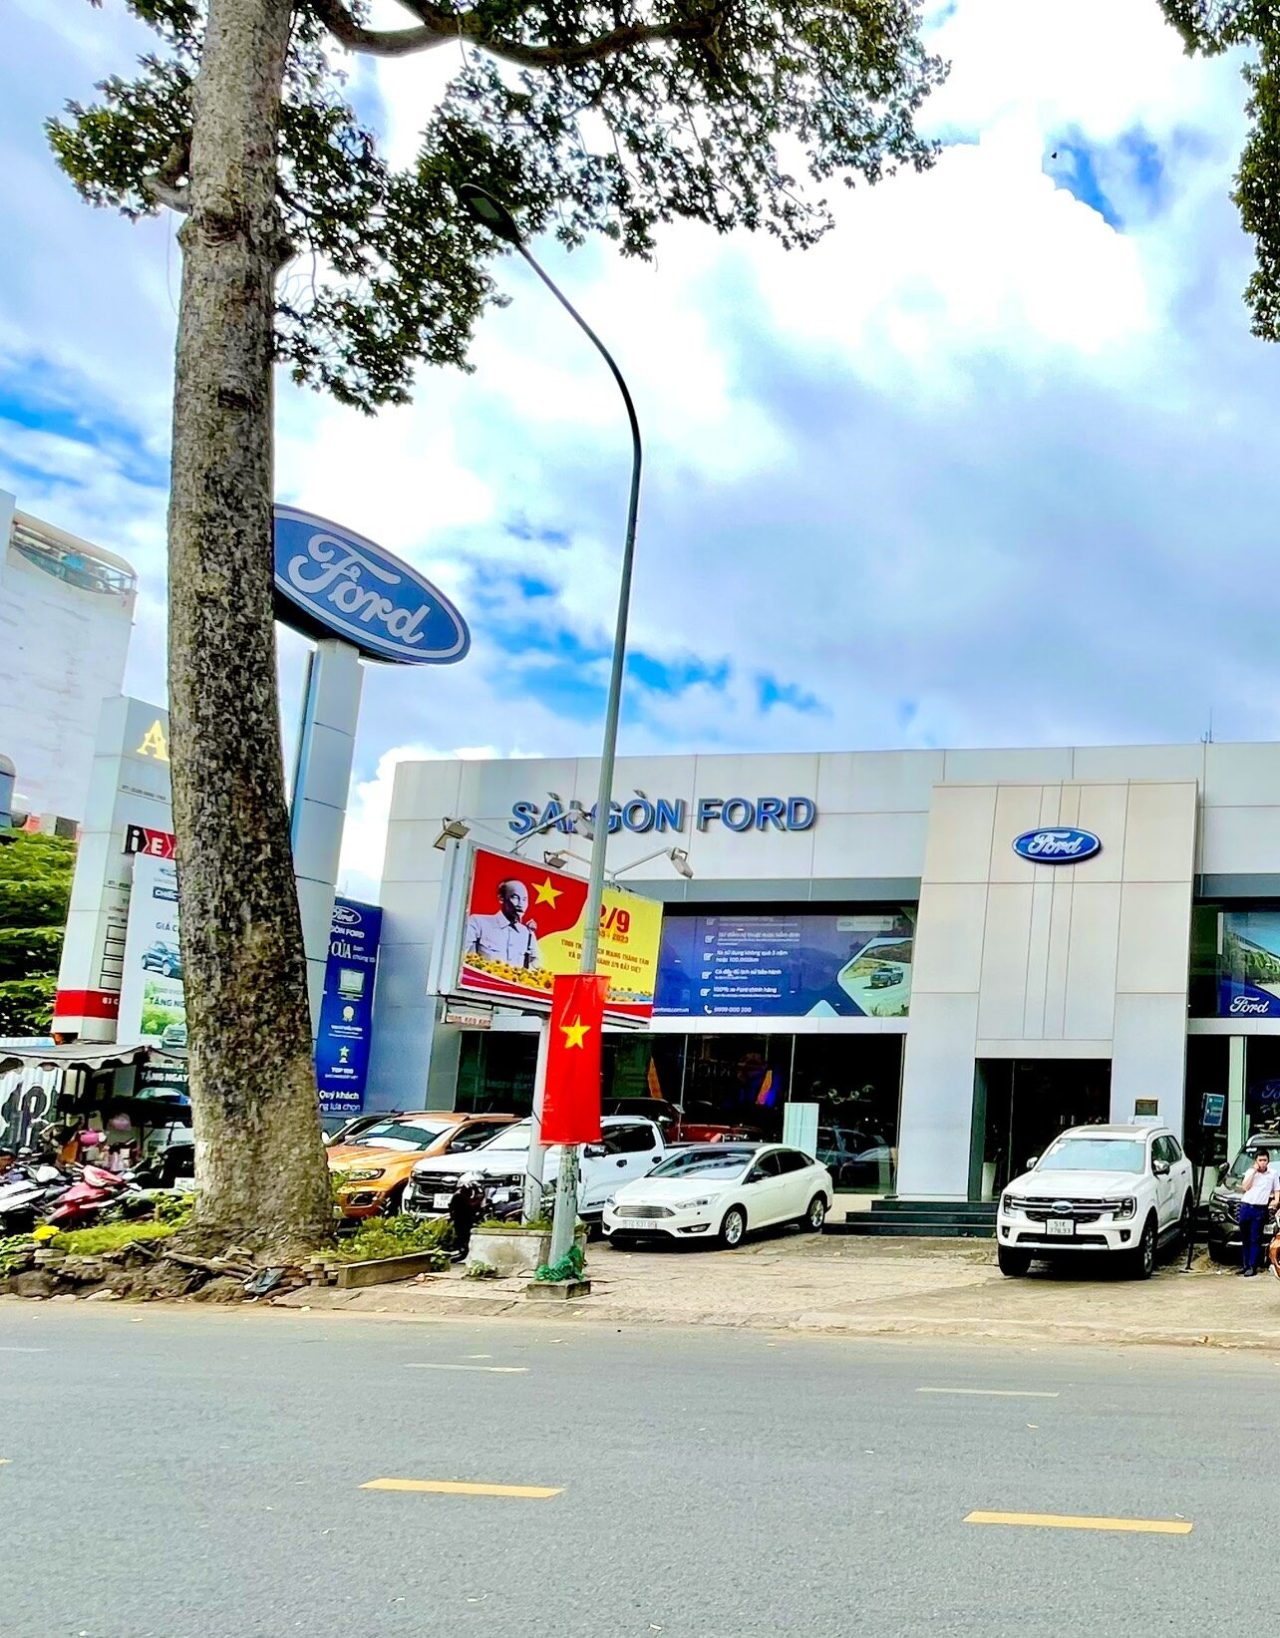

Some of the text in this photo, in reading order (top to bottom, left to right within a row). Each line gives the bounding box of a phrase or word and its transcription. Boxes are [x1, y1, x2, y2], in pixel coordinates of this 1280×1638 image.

[288, 533, 431, 645] Ford
[696, 796, 818, 833] FORD
[1027, 832, 1084, 855] Ford
[1229, 995, 1270, 1014] Ford
